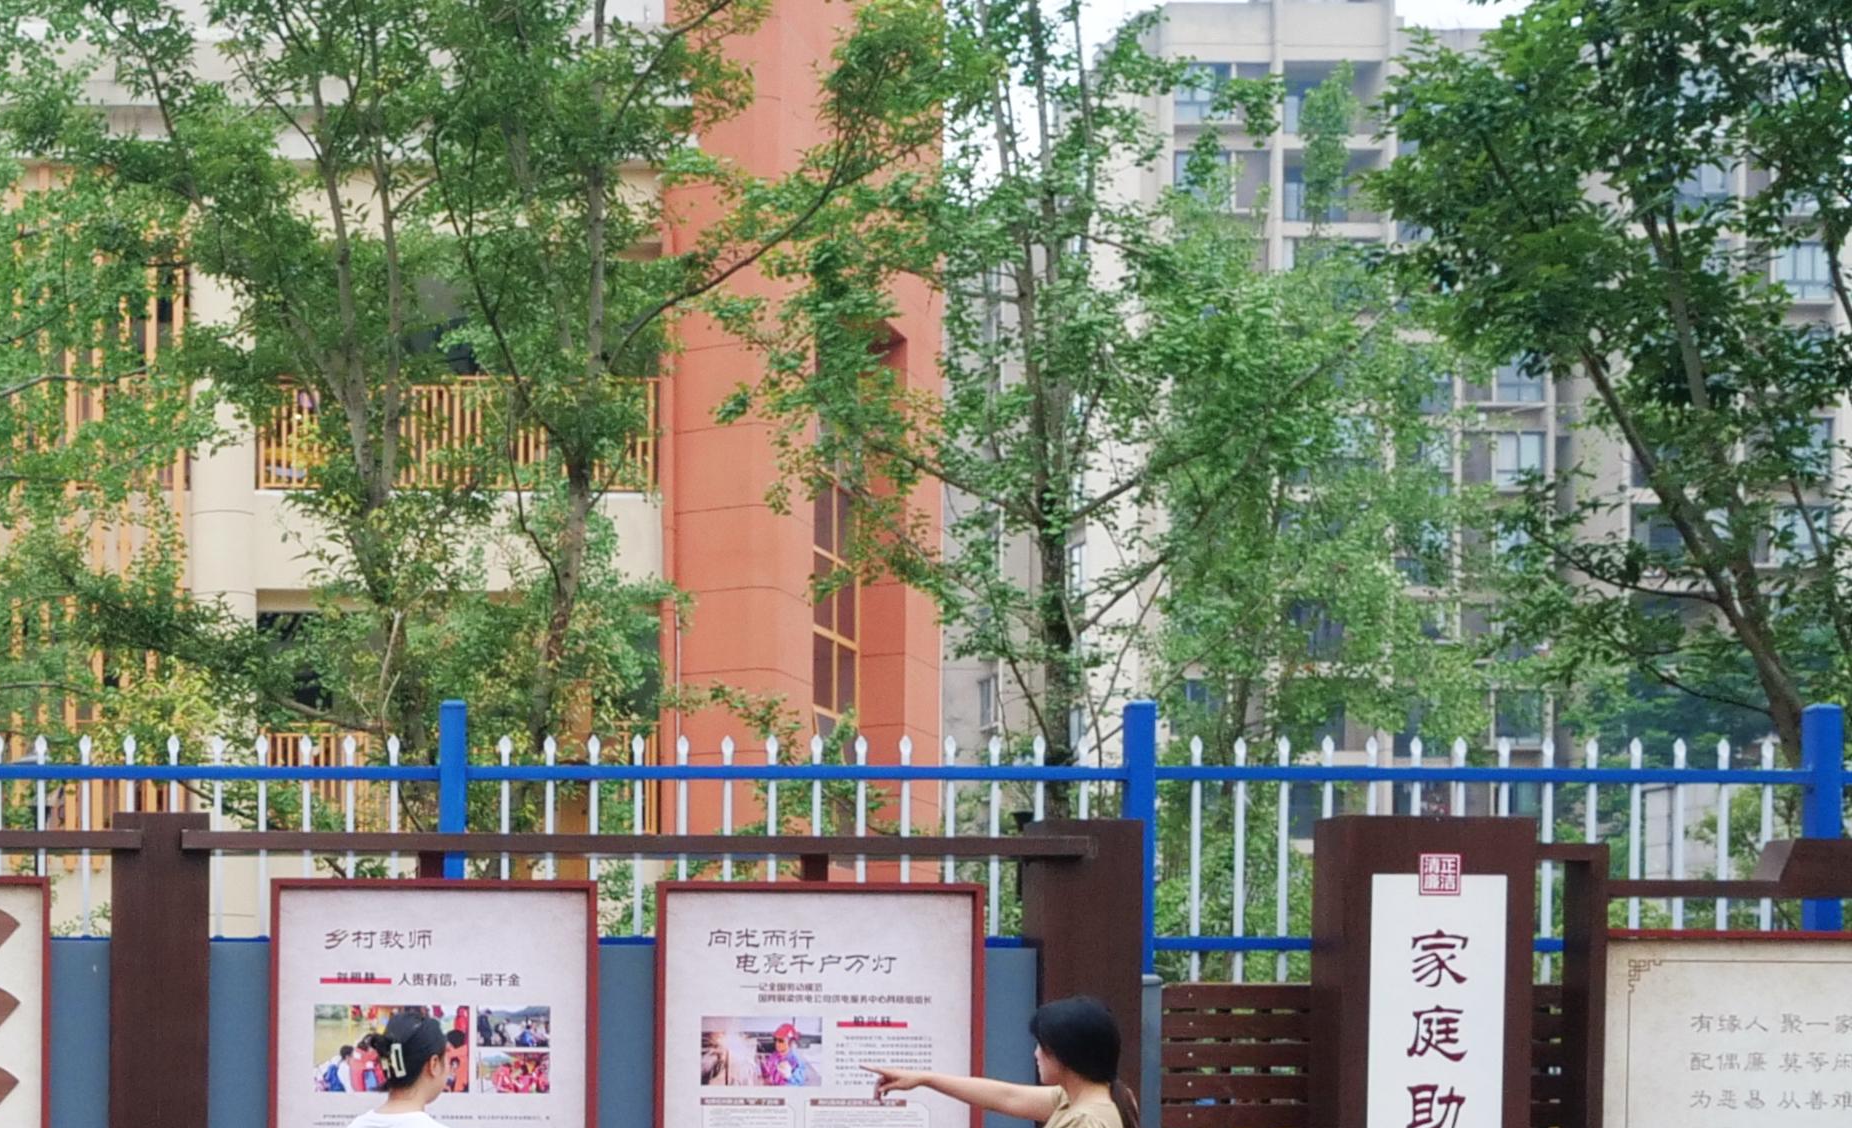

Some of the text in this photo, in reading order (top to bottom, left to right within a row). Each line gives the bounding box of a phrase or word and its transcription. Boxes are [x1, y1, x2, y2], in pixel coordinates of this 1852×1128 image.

[324, 929, 433, 950] 乡村教师
[707, 928, 816, 950] 向光而行
[735, 952, 898, 975] 电亮千户万灯
[1690, 1013, 1768, 1033] 有缘人
